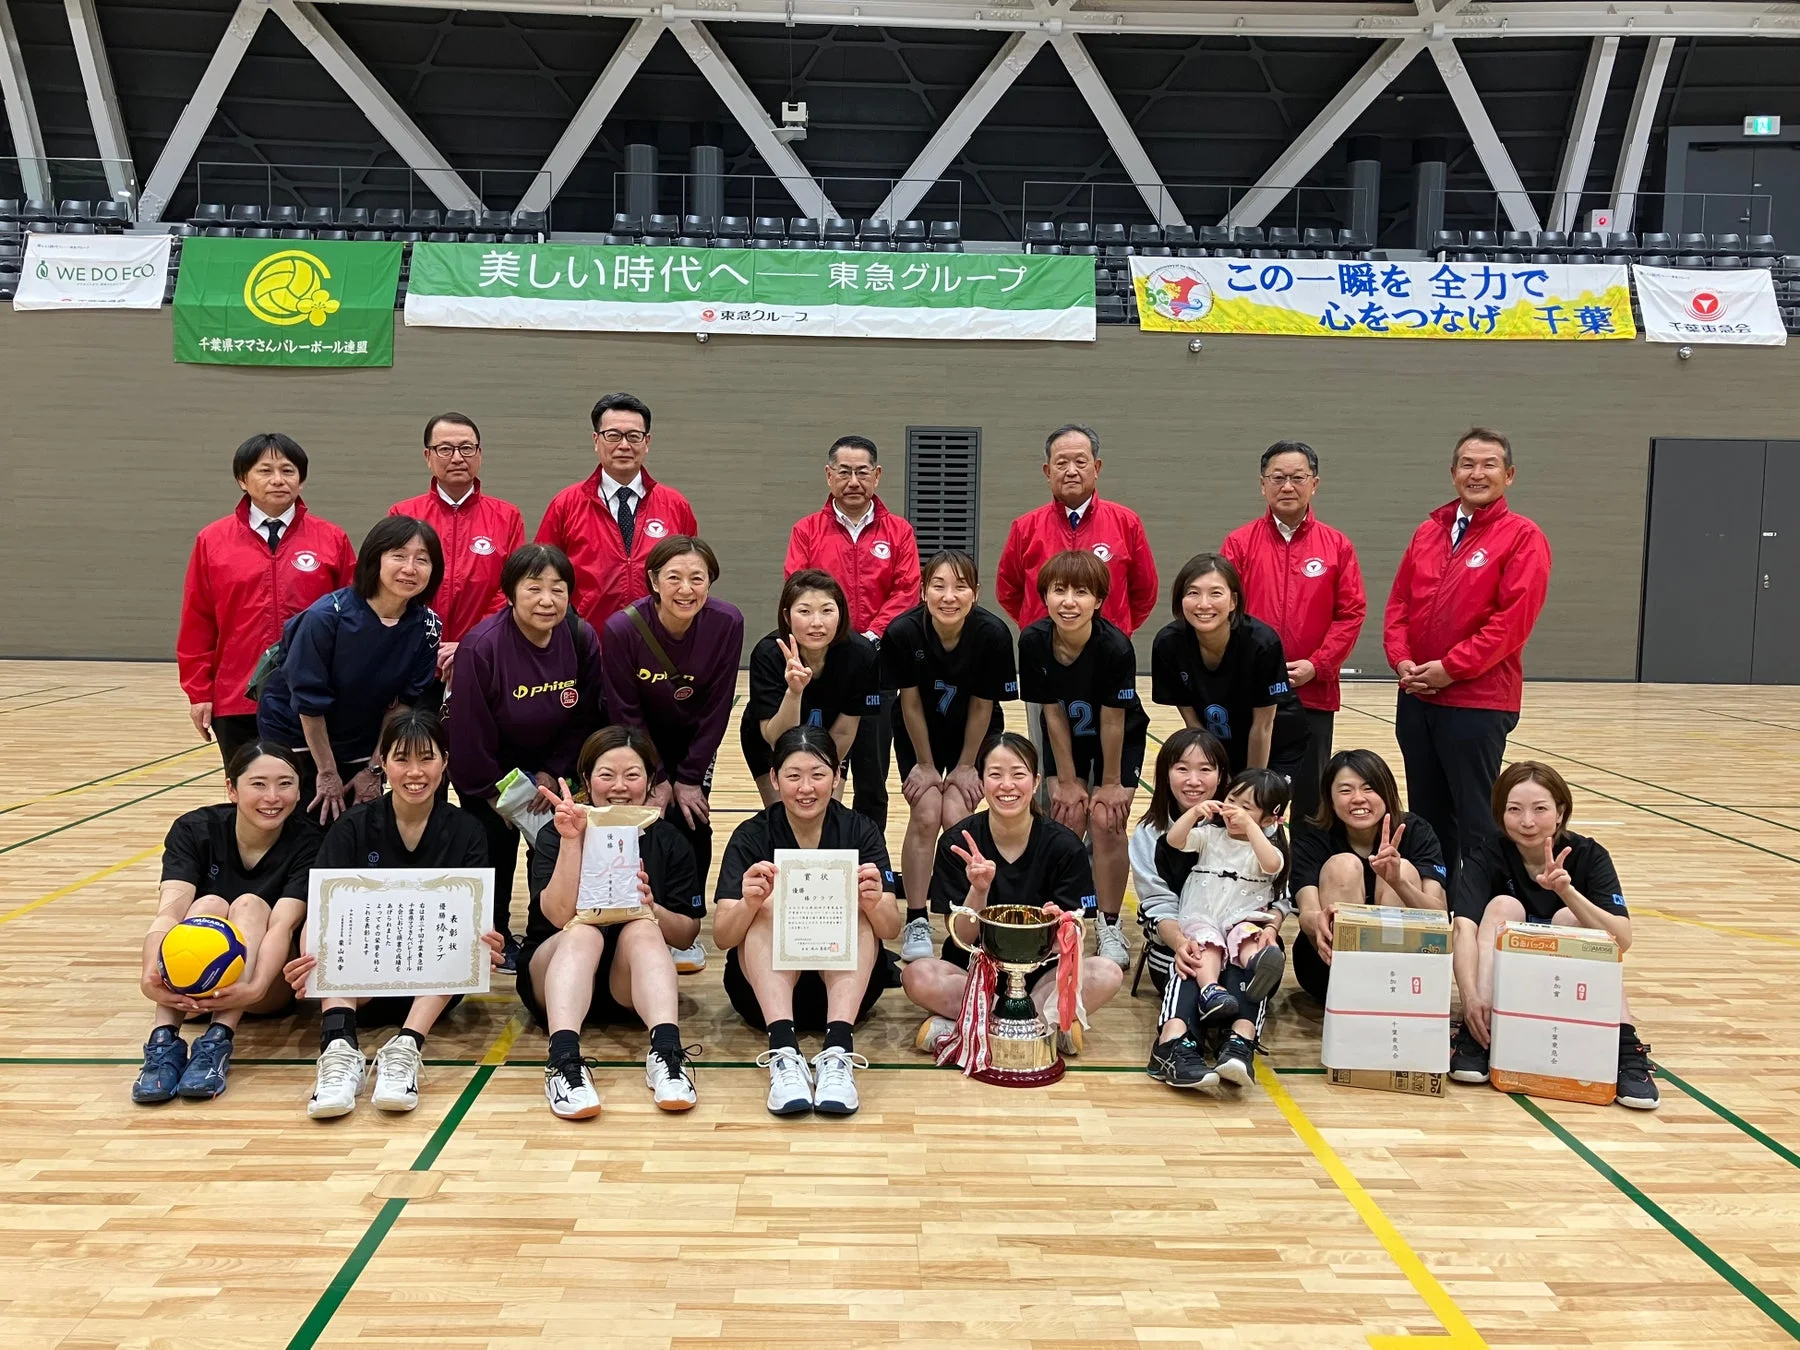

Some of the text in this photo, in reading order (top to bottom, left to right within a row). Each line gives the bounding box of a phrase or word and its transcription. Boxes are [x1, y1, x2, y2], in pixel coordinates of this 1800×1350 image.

[56, 266, 86, 281] WE
[91, 267, 118, 281] DO
[1227, 263, 1411, 298] この一瞬を
[1428, 263, 1549, 301] 全力で
[1320, 301, 1617, 335] 心をつなげ 千葉
[199, 336, 369, 354] 千葉県ママさんバレーボール連盟
[530, 679, 577, 697] phite
[934, 680, 957, 718] 7
[1203, 703, 1232, 740] 8
[193, 917, 225, 929] MIKASA
[438, 902, 446, 919] 優勝
[449, 914, 458, 951] 表彰状
